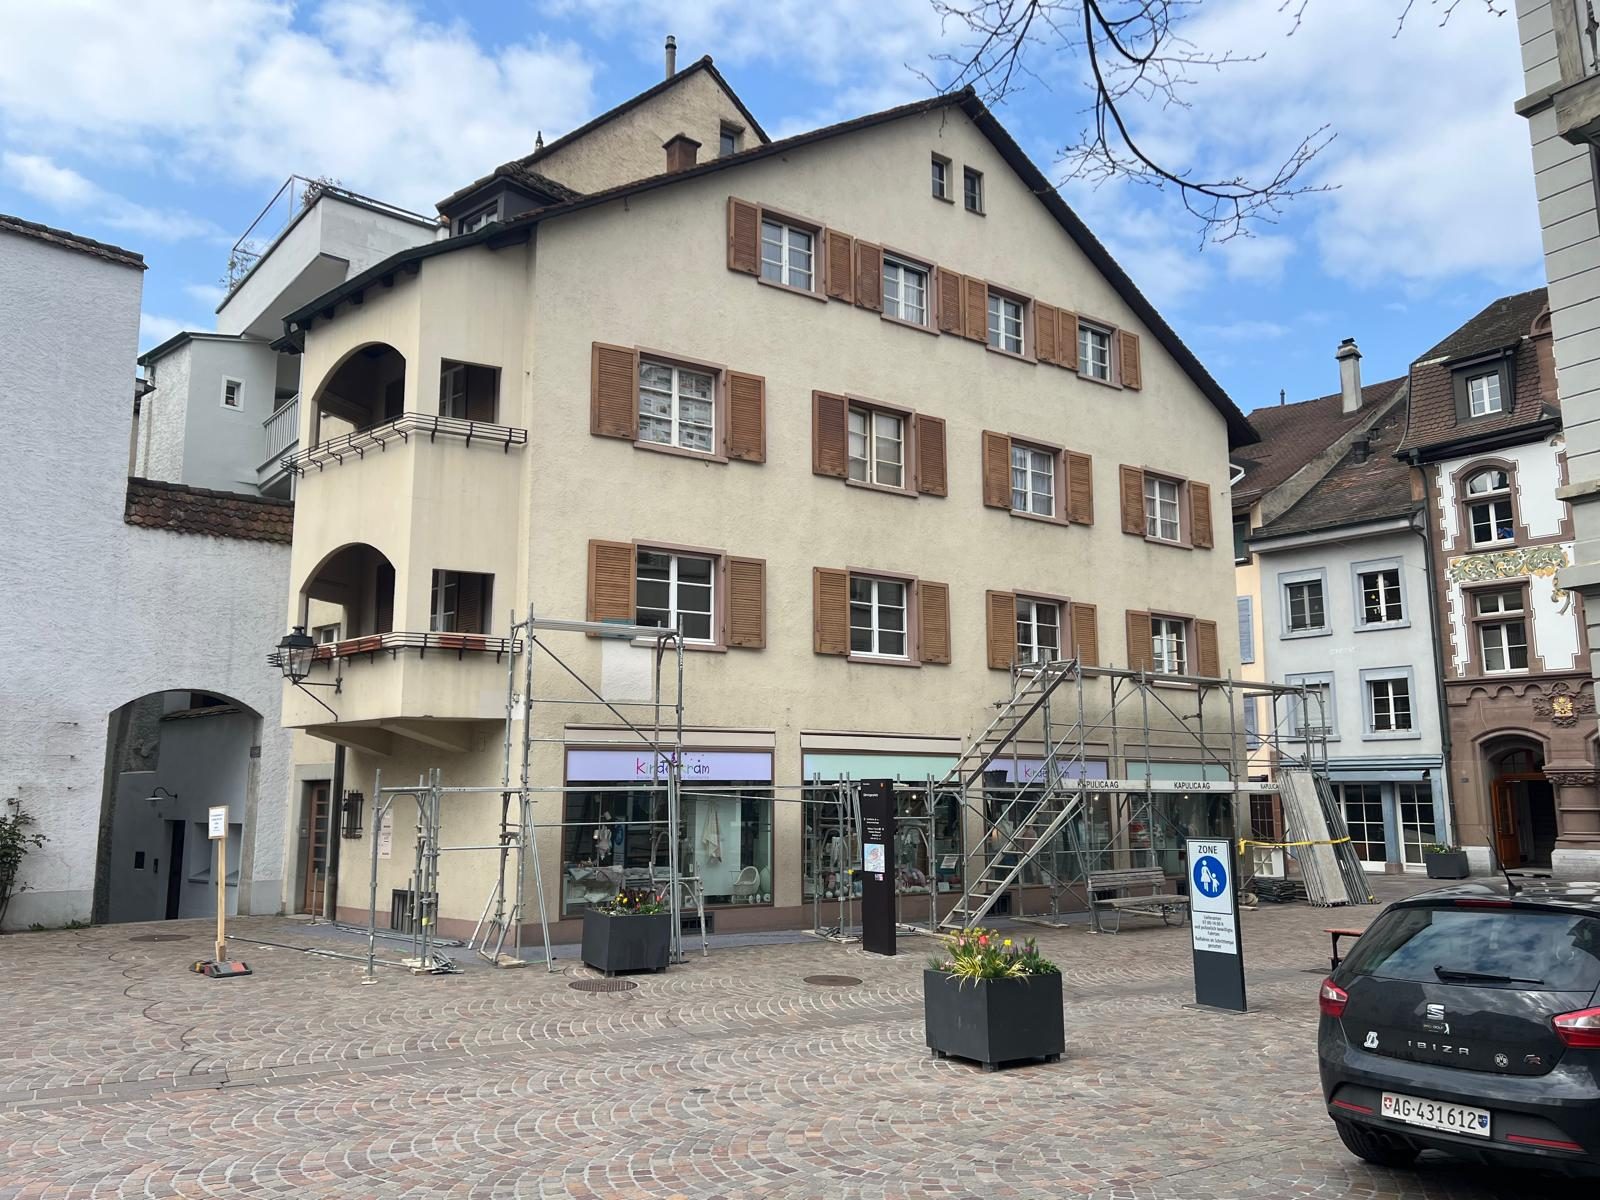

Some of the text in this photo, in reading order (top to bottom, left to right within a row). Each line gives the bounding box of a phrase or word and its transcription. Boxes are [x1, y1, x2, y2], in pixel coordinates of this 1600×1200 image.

[1077, 780, 1119, 789] KPULICA AG
[1174, 781, 1211, 790] KAPULICA AG
[1198, 844, 1218, 854] ZONE
[1407, 1040, 1469, 1056] IBIZA
